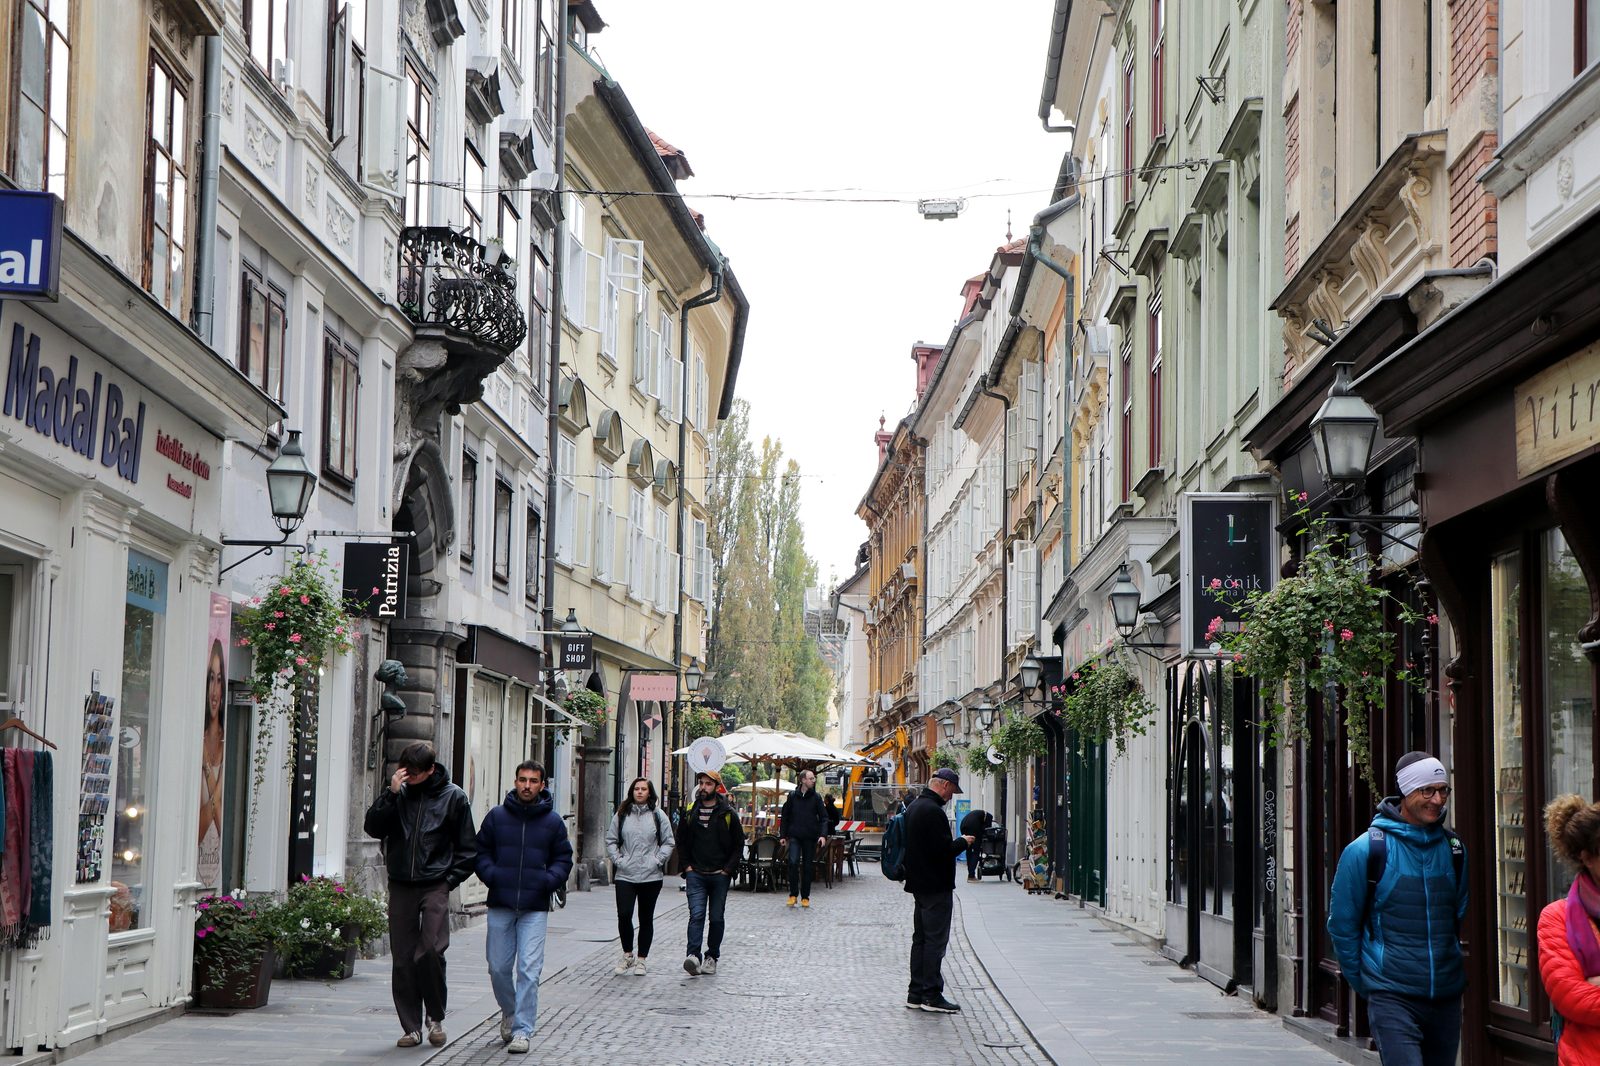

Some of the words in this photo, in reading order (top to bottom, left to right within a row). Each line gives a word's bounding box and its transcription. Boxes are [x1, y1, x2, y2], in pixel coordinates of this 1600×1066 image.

[3, 322, 102, 460] Madal
[101, 383, 146, 484] Bal
[156, 429, 183, 465] izdelki
[182, 451, 192, 470] za
[192, 452, 210, 480] dom
[379, 546, 400, 617] Patrizia
[1202, 574, 1261, 589] Lčnik
[565, 654, 586, 663] SHOP
[567, 643, 585, 652] GIFT
